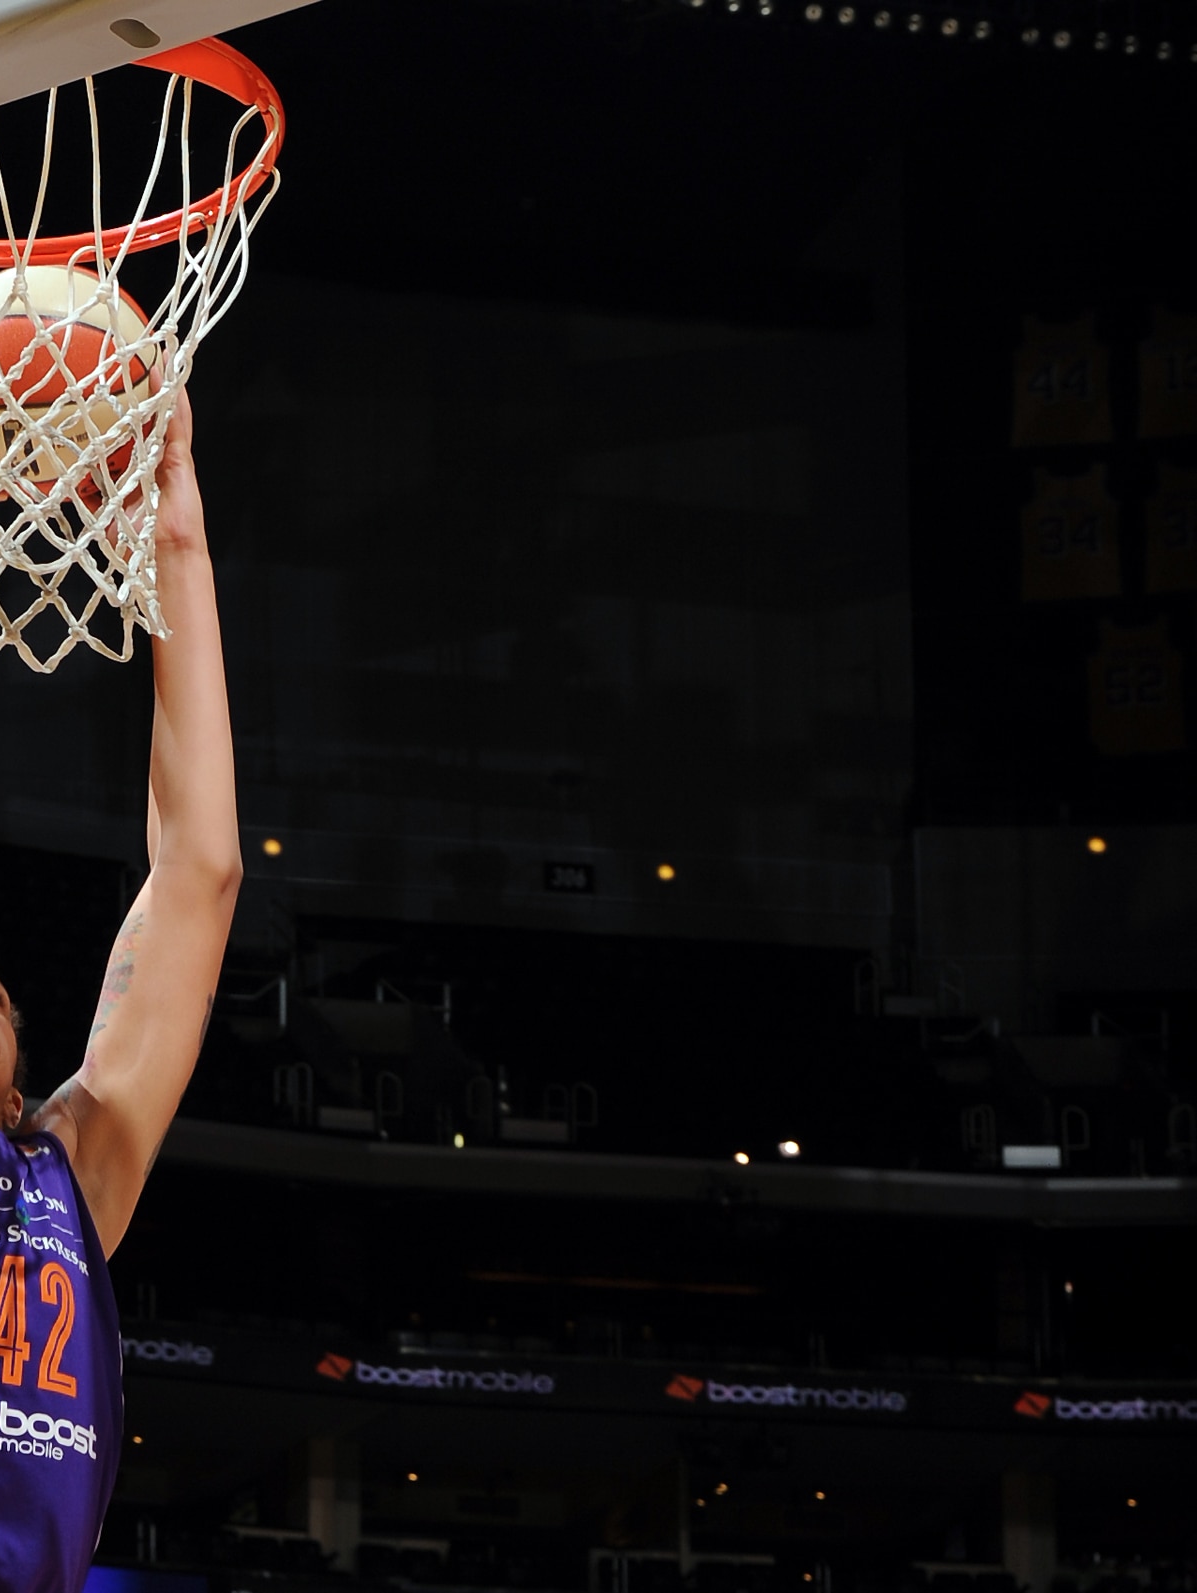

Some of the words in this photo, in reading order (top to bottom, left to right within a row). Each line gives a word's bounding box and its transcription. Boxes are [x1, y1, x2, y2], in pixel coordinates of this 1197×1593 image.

[1027, 355, 1094, 406] 44
[1037, 511, 1103, 557] 34
[1106, 663, 1167, 711] 52
